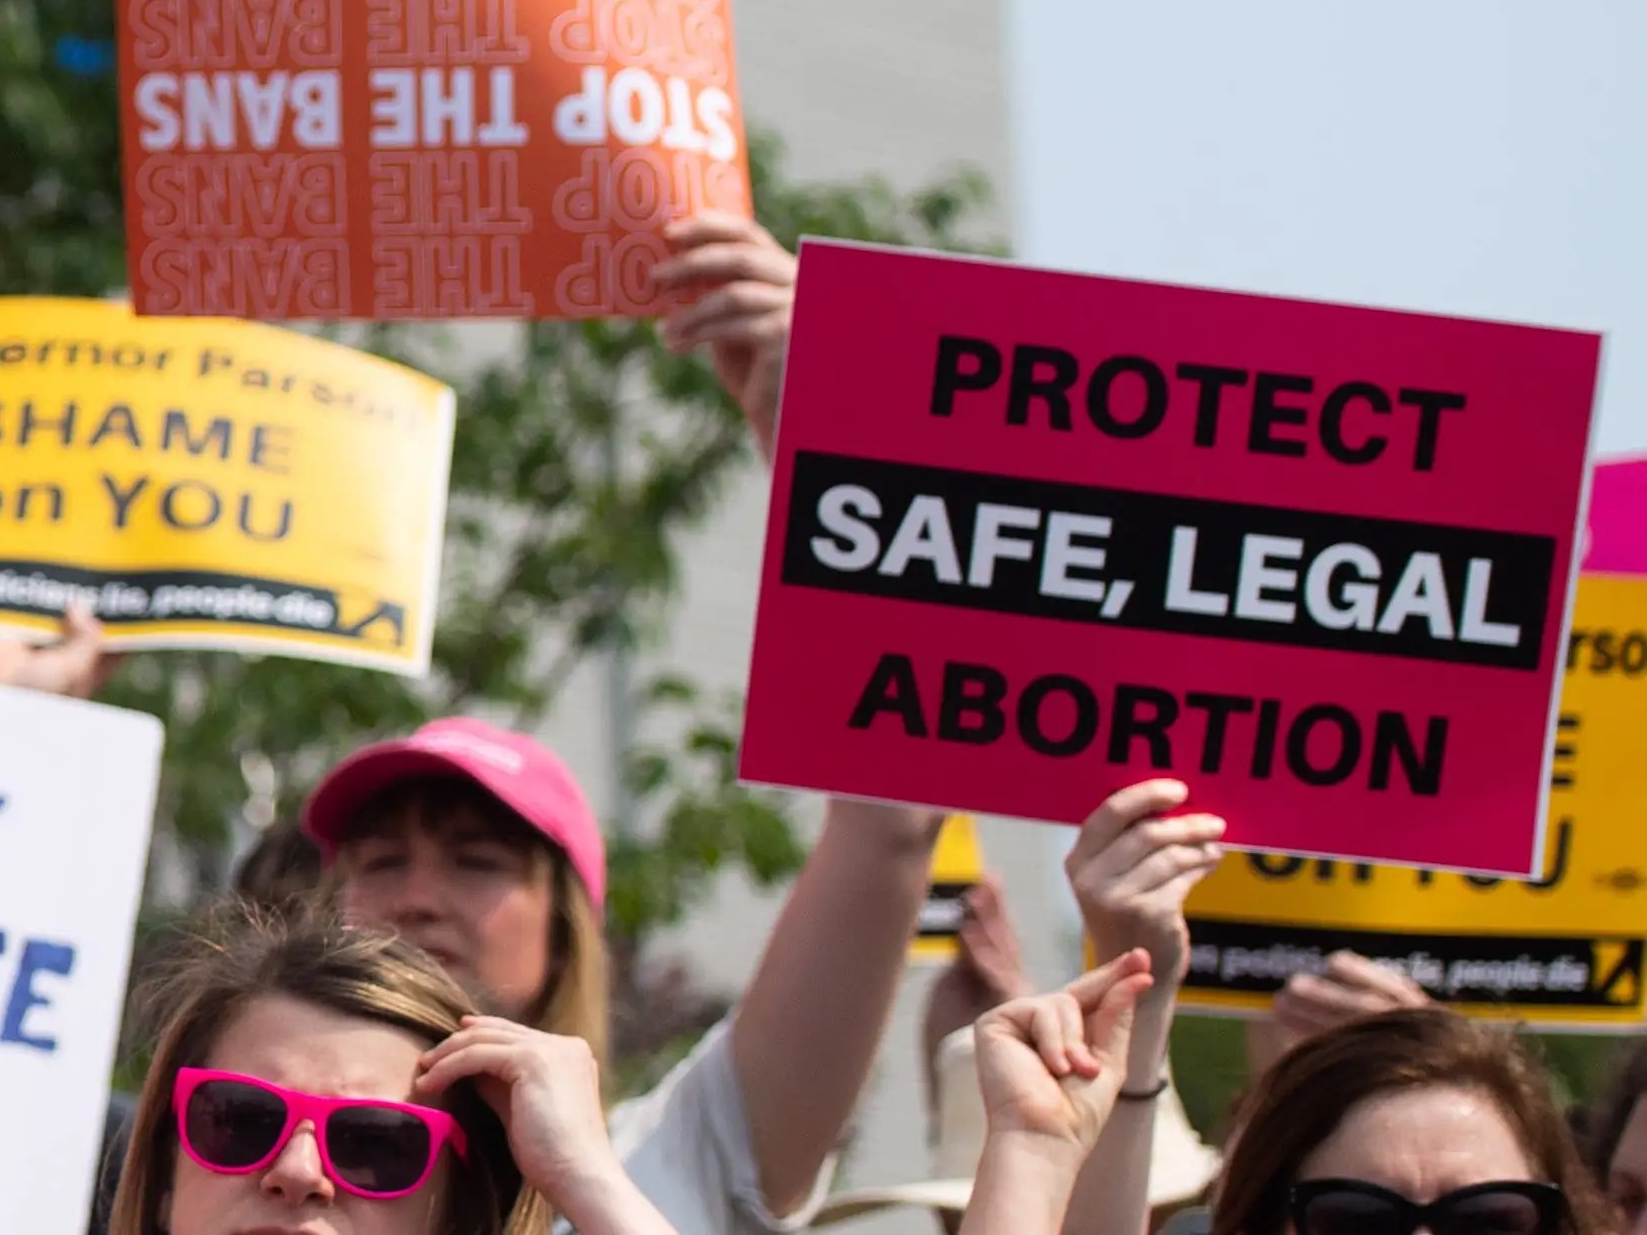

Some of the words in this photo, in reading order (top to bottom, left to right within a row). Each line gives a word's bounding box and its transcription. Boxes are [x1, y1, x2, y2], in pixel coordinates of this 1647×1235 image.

[135, 69, 343, 151] BANS
[370, 67, 529, 146] THE
[552, 65, 737, 161] STOP
[136, 153, 346, 238] BANS
[371, 149, 533, 233] THE
[141, 238, 350, 317] BANS
[372, 233, 535, 316] THE
[929, 335, 1466, 472] PROTECT
[102, 472, 294, 543] YOU
[810, 484, 1134, 618] SAFE,
[1164, 526, 1522, 648] LEGAL
[847, 653, 1449, 796] ABORTION
